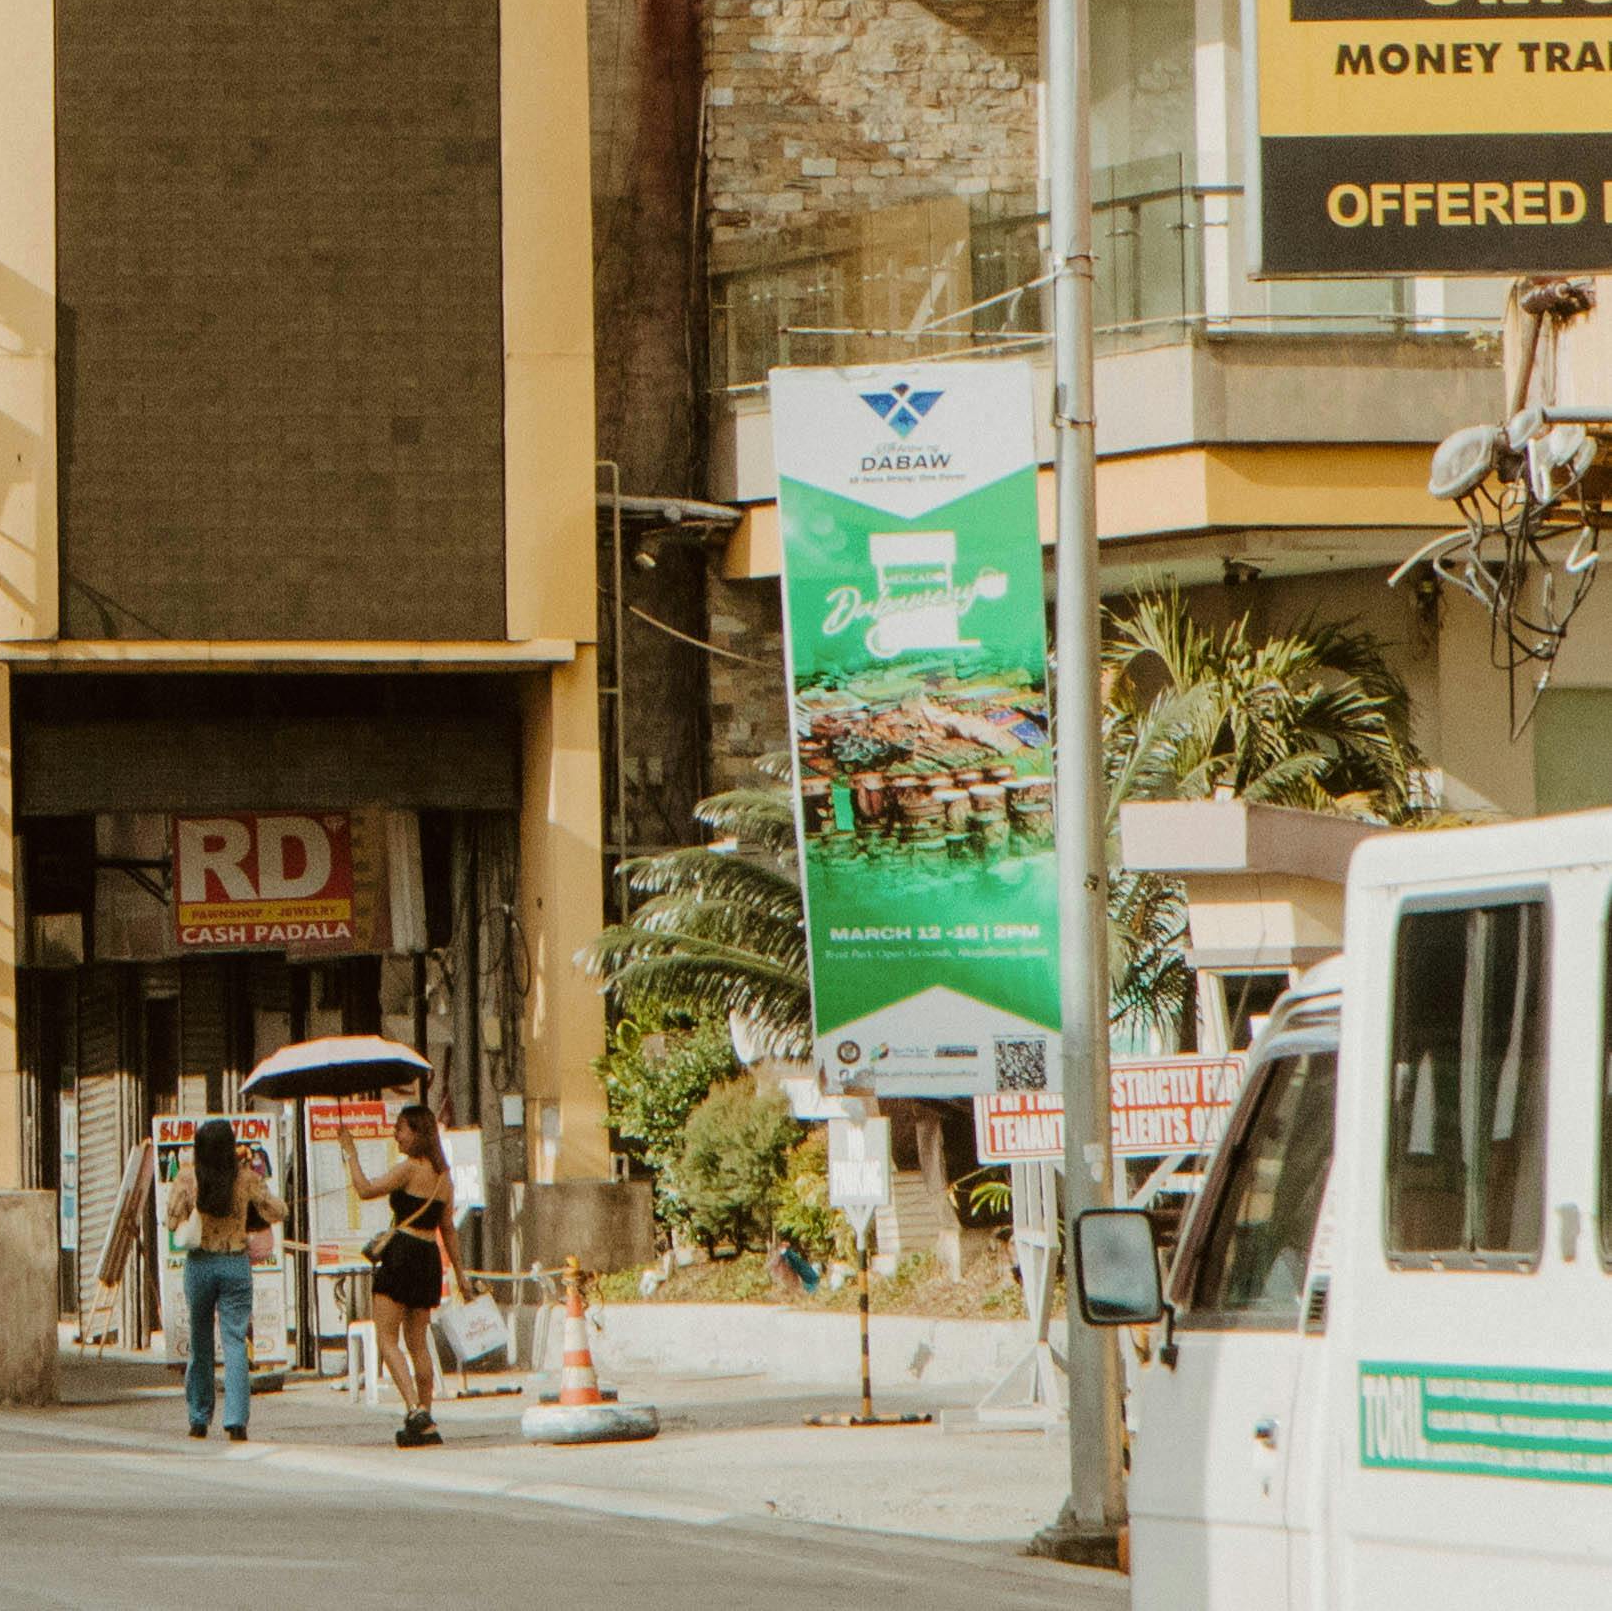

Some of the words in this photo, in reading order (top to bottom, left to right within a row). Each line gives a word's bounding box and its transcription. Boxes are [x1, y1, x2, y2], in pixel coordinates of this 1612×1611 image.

[1335, 42, 1502, 76] MONEY
[1518, 40, 1612, 73] TRA
[1327, 181, 1586, 228] OFFERED
[861, 453, 953, 472] DABAW
[177, 816, 332, 902] RD
[182, 925, 246, 945] CASH
[254, 920, 353, 942] PADALA
[830, 926, 912, 941] MARCH
[1112, 1069, 1197, 1108] STRICTLY
